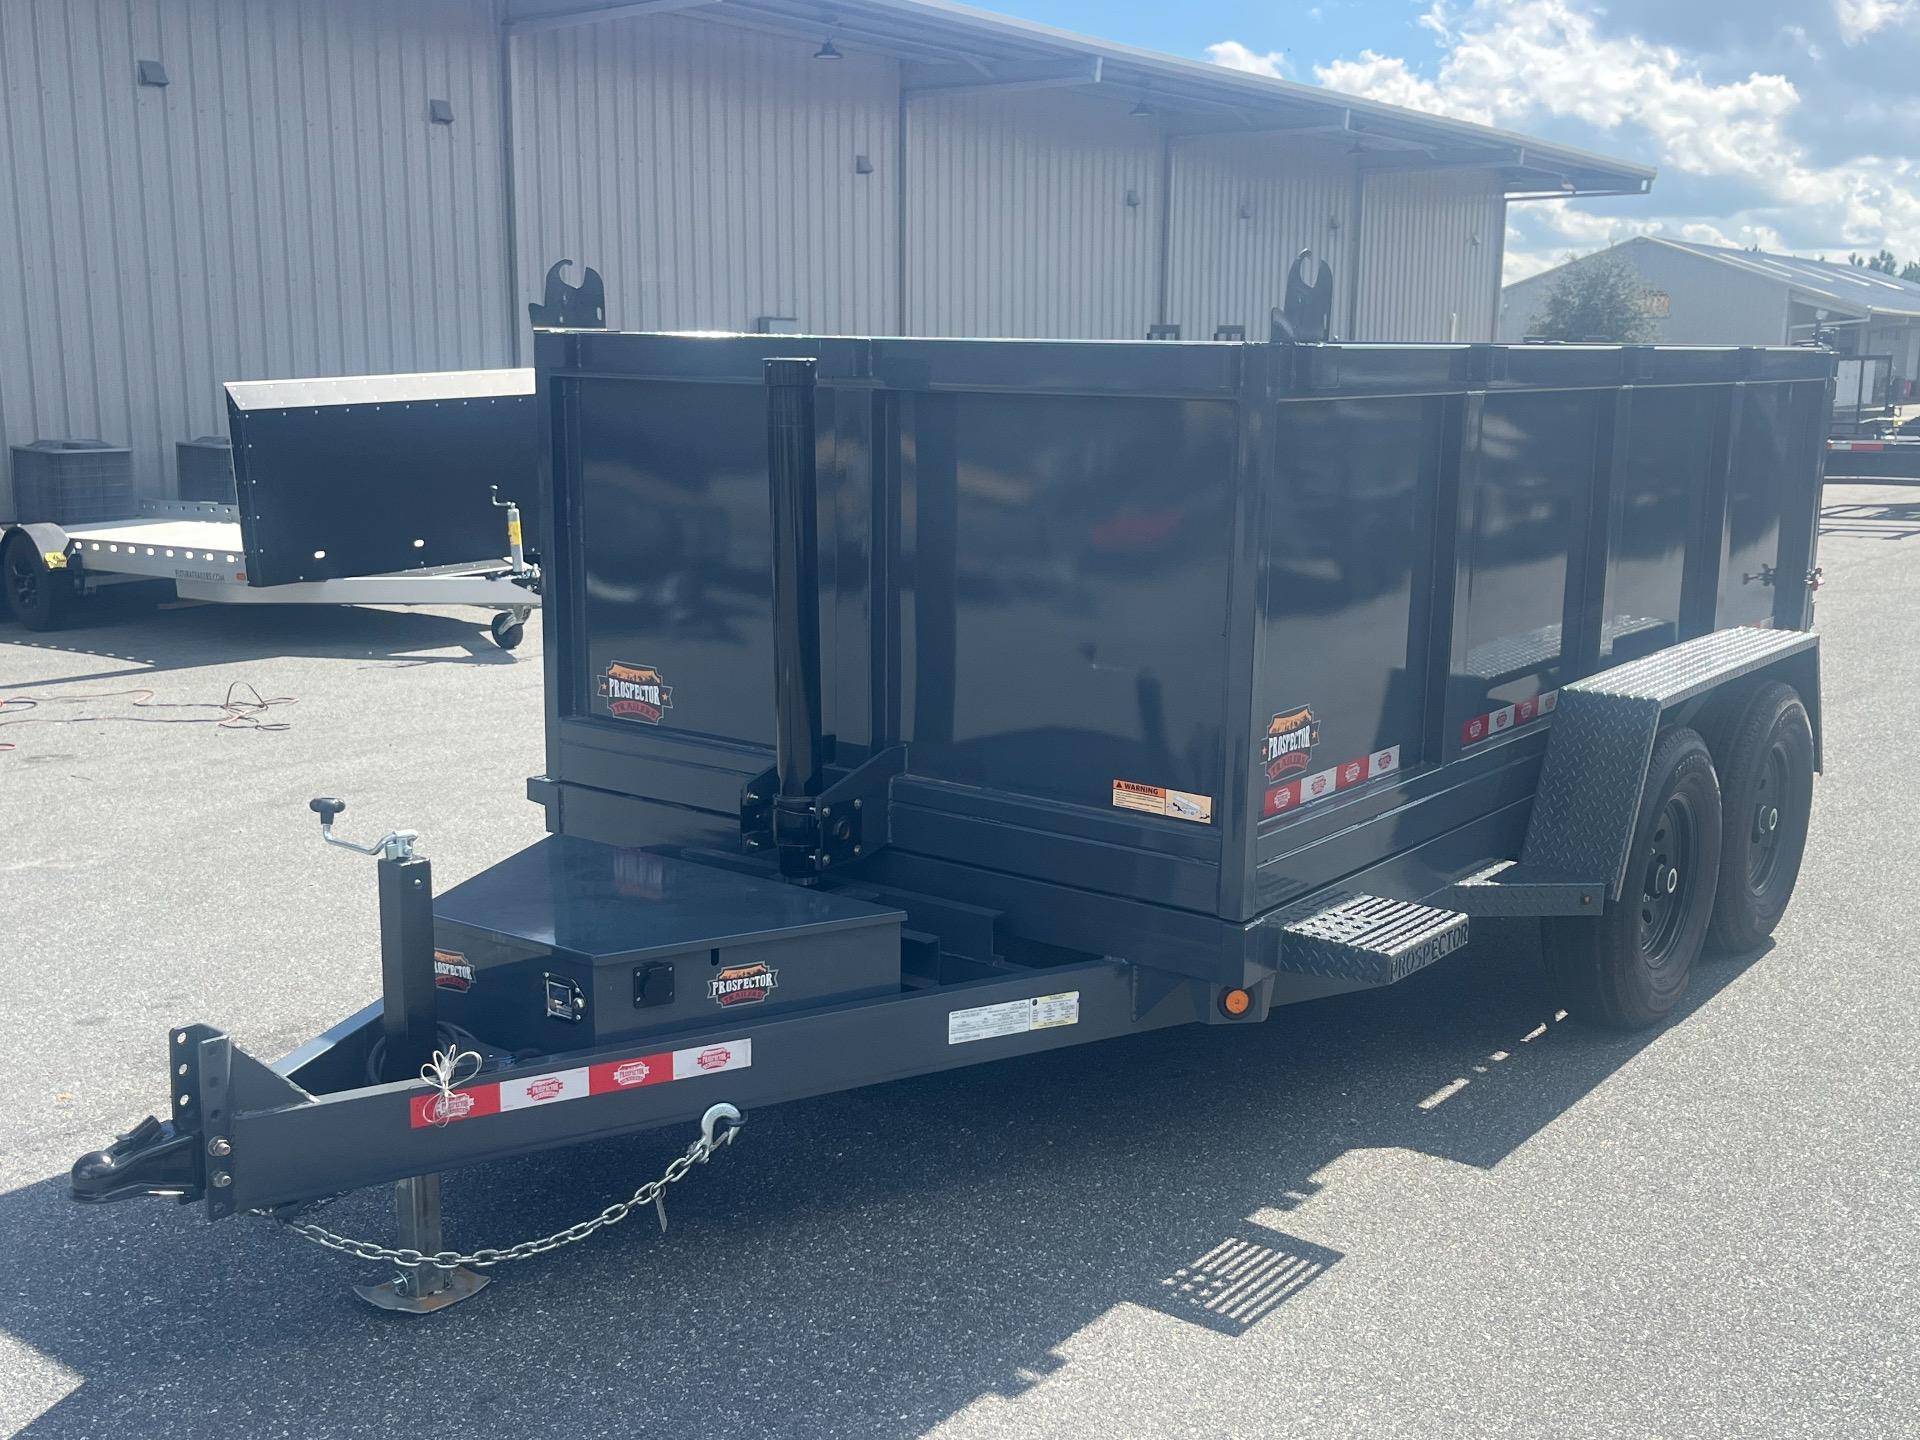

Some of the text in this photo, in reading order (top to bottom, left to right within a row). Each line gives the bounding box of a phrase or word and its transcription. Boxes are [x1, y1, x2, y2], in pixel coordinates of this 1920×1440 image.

[608, 677, 661, 706] PROSPECTOR
[1267, 725, 1311, 762] PROSPECTOR
[1270, 754, 1308, 777] TRAILERS
[1124, 782, 1159, 796] WARNING
[1390, 922, 1469, 983] PROSPECTOR
[712, 973, 774, 996] PROSPECTOR
